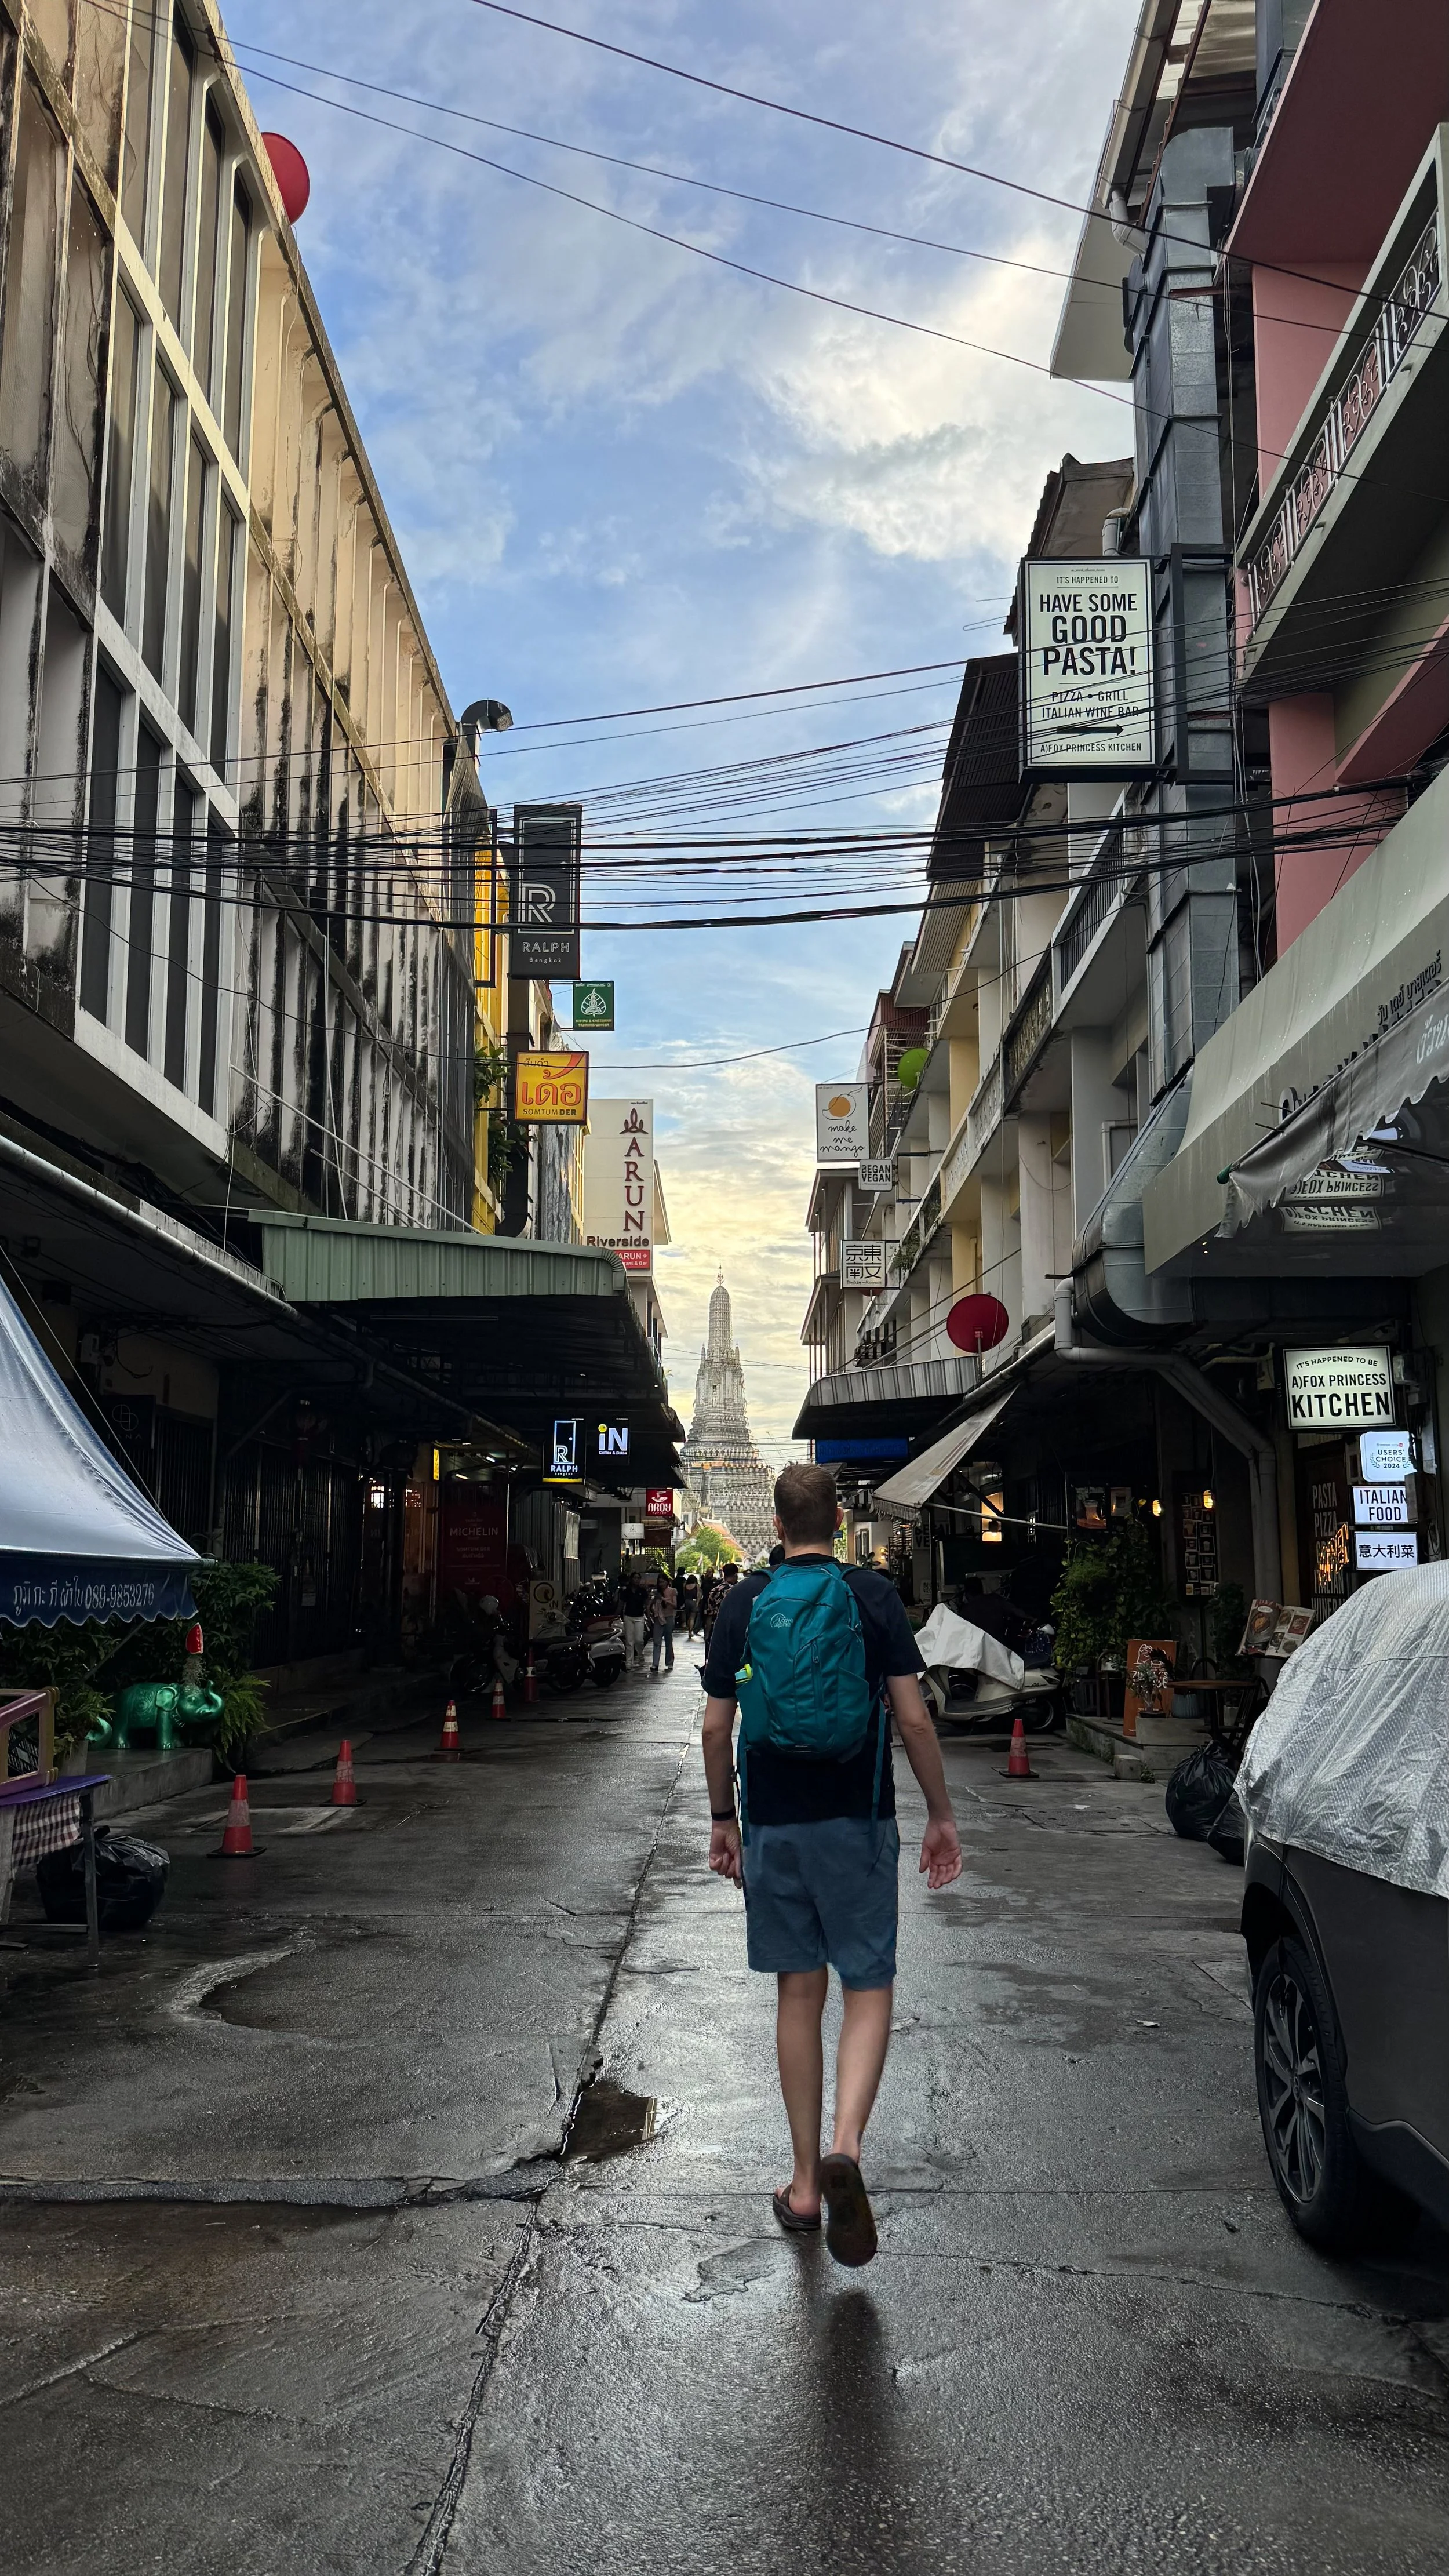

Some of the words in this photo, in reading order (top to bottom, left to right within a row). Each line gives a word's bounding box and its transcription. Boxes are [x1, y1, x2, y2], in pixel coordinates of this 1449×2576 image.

[1040, 594, 1083, 612] HAVE
[1088, 593, 1137, 612] SOME
[1052, 615, 1127, 643] GOOD
[1043, 646, 1135, 675] PASTA!
[1052, 691, 1083, 702] PIZZA
[1098, 690, 1128, 701] GRILL
[1042, 707, 1082, 718] ITALIAN
[1086, 706, 1114, 718] WINE
[1117, 705, 1139, 718] BAR
[1066, 744, 1105, 752] PRINCESS
[1108, 743, 1141, 752] KITCHEN
[522, 942, 570, 952] RALPH
[828, 1120, 857, 1133] make
[820, 1145, 865, 1158] mango
[862, 1165, 890, 1173] BEGAN
[624, 1137, 645, 1231] ARUN
[862, 1174, 890, 1182] VEGAN
[587, 1235, 650, 1247] Riverside
[1296, 1361, 1309, 1370] IT'S
[1311, 1356, 1352, 1365] HAPPENED
[1368, 1359, 1379, 1367] BE
[1291, 1376, 1326, 1389] A)FOX
[1328, 1373, 1386, 1387] PRINCESS
[1292, 1392, 1390, 1418] KITCHEN
[1312, 1482, 1338, 1509] PASTA
[1360, 1490, 1407, 1504] ITALIAN
[1369, 1507, 1401, 1521] FOOD
[1314, 1511, 1338, 1537] PIZZA
[450, 1527, 498, 1537] MICHELIN
[1359, 1544, 1415, 1558] 意大利菜
[85, 1582, 155, 1610] 089-9853276
